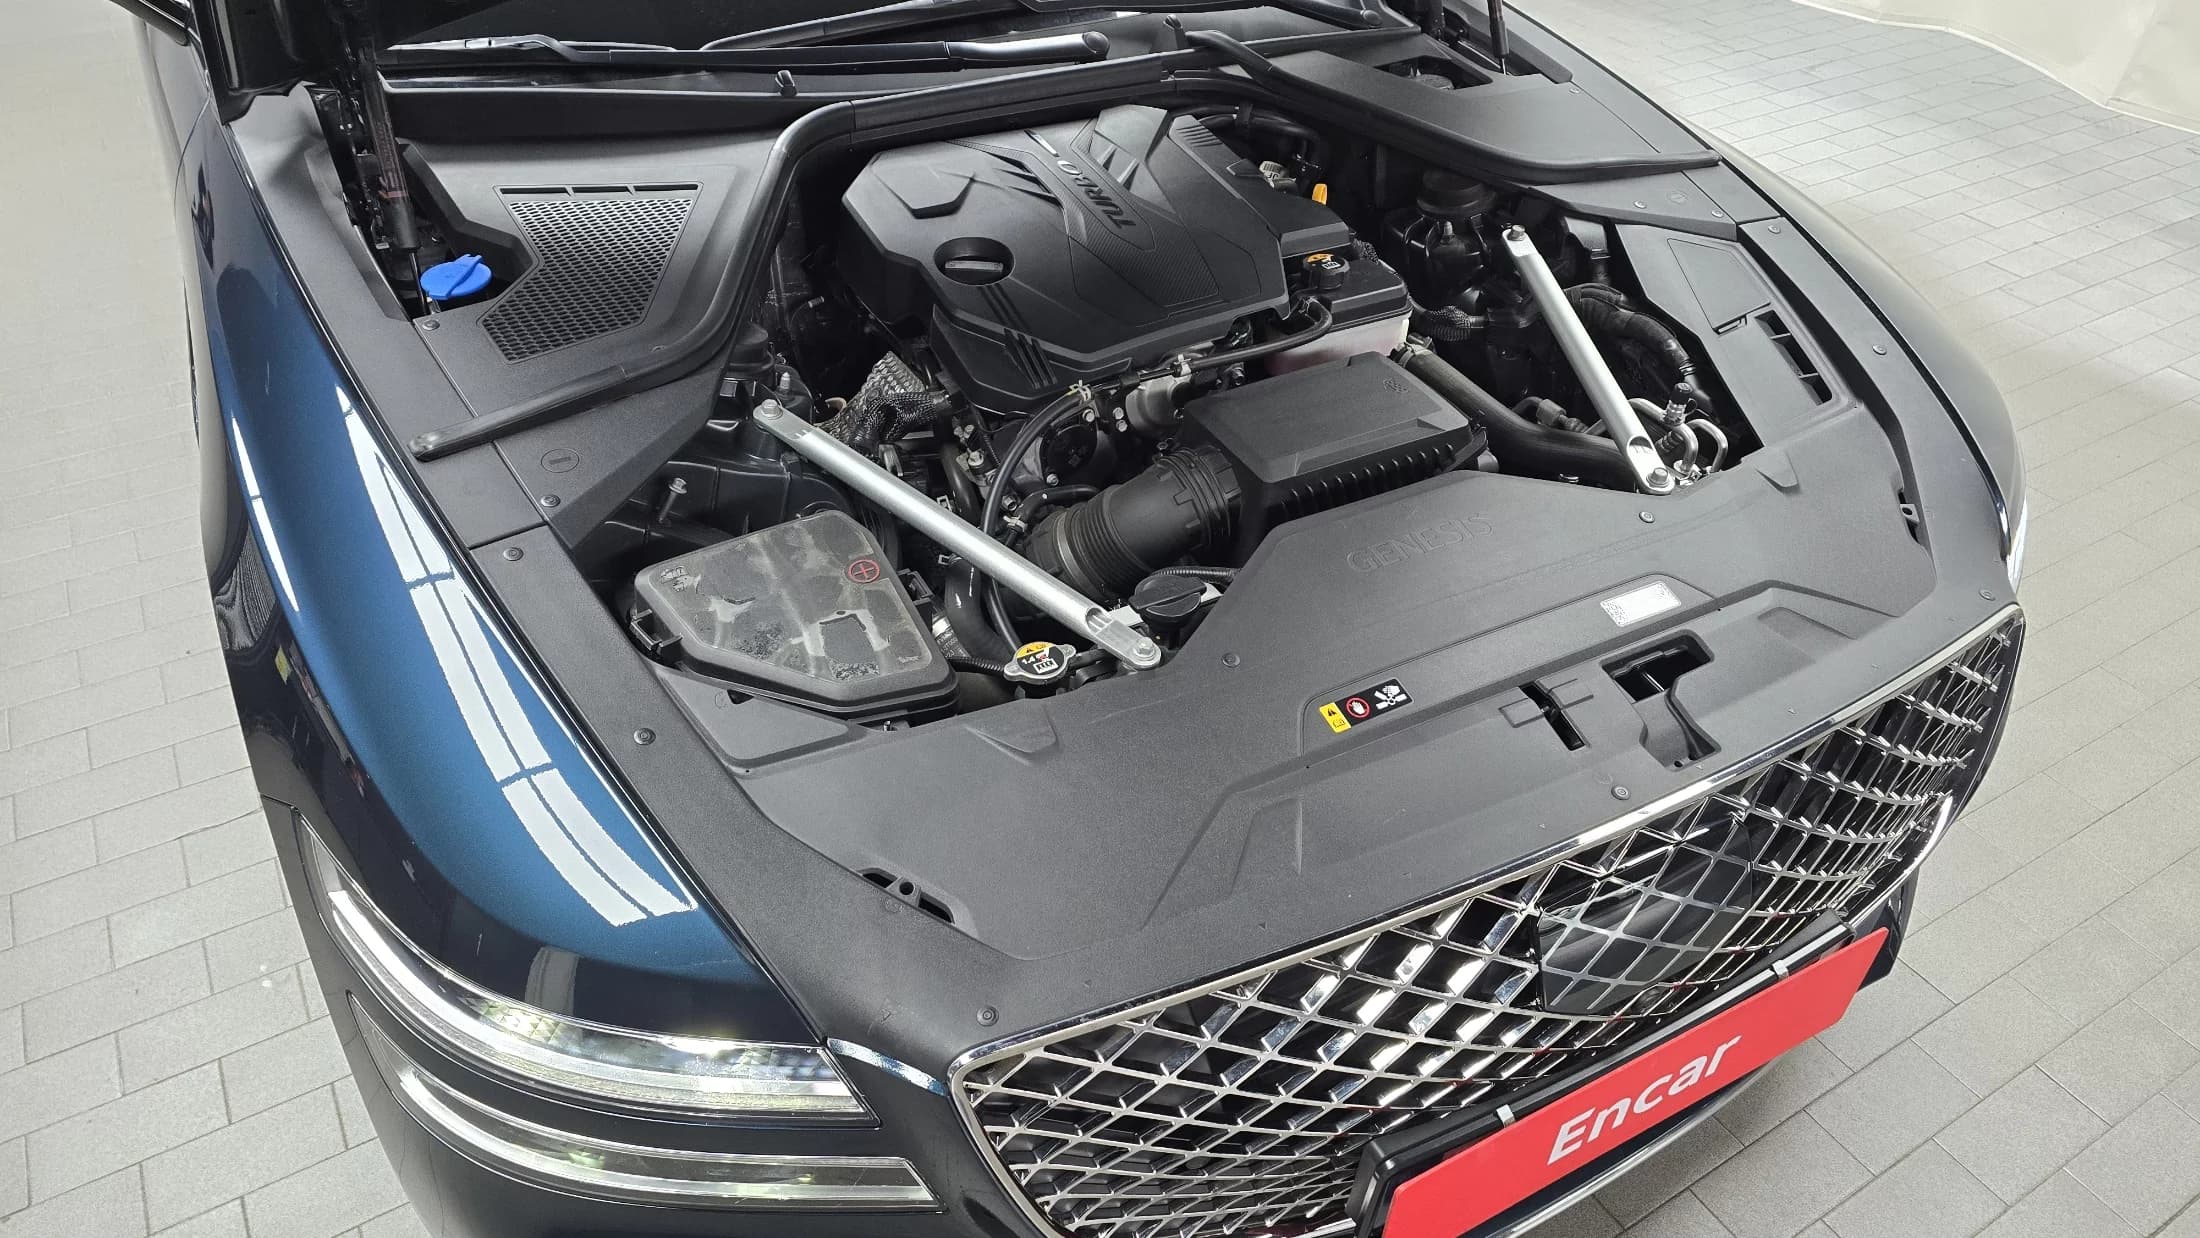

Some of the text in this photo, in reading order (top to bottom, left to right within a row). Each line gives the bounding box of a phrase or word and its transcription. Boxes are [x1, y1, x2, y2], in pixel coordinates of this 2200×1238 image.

[1057, 160, 1137, 229] TURBO
[1346, 513, 1494, 572] GENESIS
[1547, 1034, 1743, 1166] Encar
